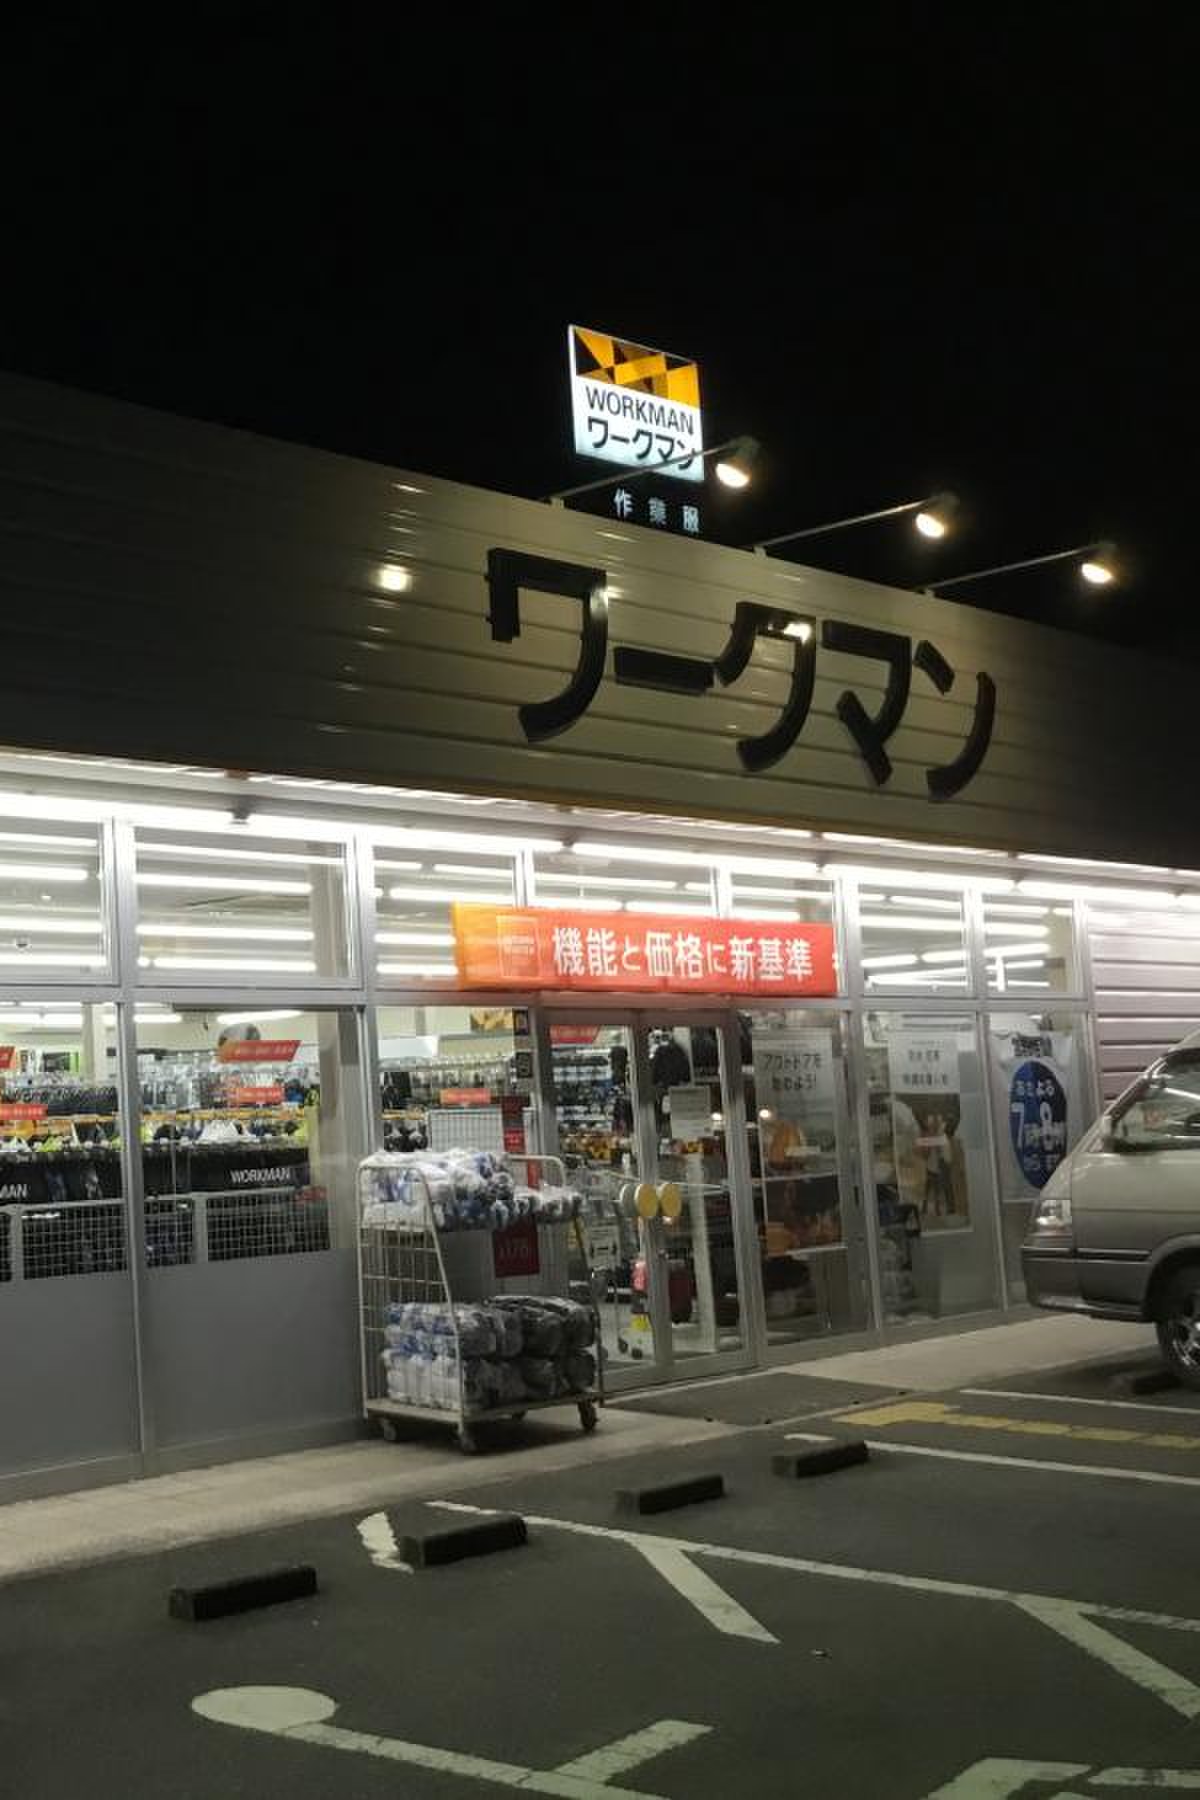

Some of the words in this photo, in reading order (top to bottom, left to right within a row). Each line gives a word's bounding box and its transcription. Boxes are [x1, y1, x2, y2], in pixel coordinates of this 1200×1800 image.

[585, 385, 694, 436] WORKMAN
[587, 415, 696, 470] ワークマン
[485, 547, 997, 801] ワークマン
[552, 926, 814, 982] 機能と価格に新基準
[229, 1166, 292, 1185] WORKMAN
